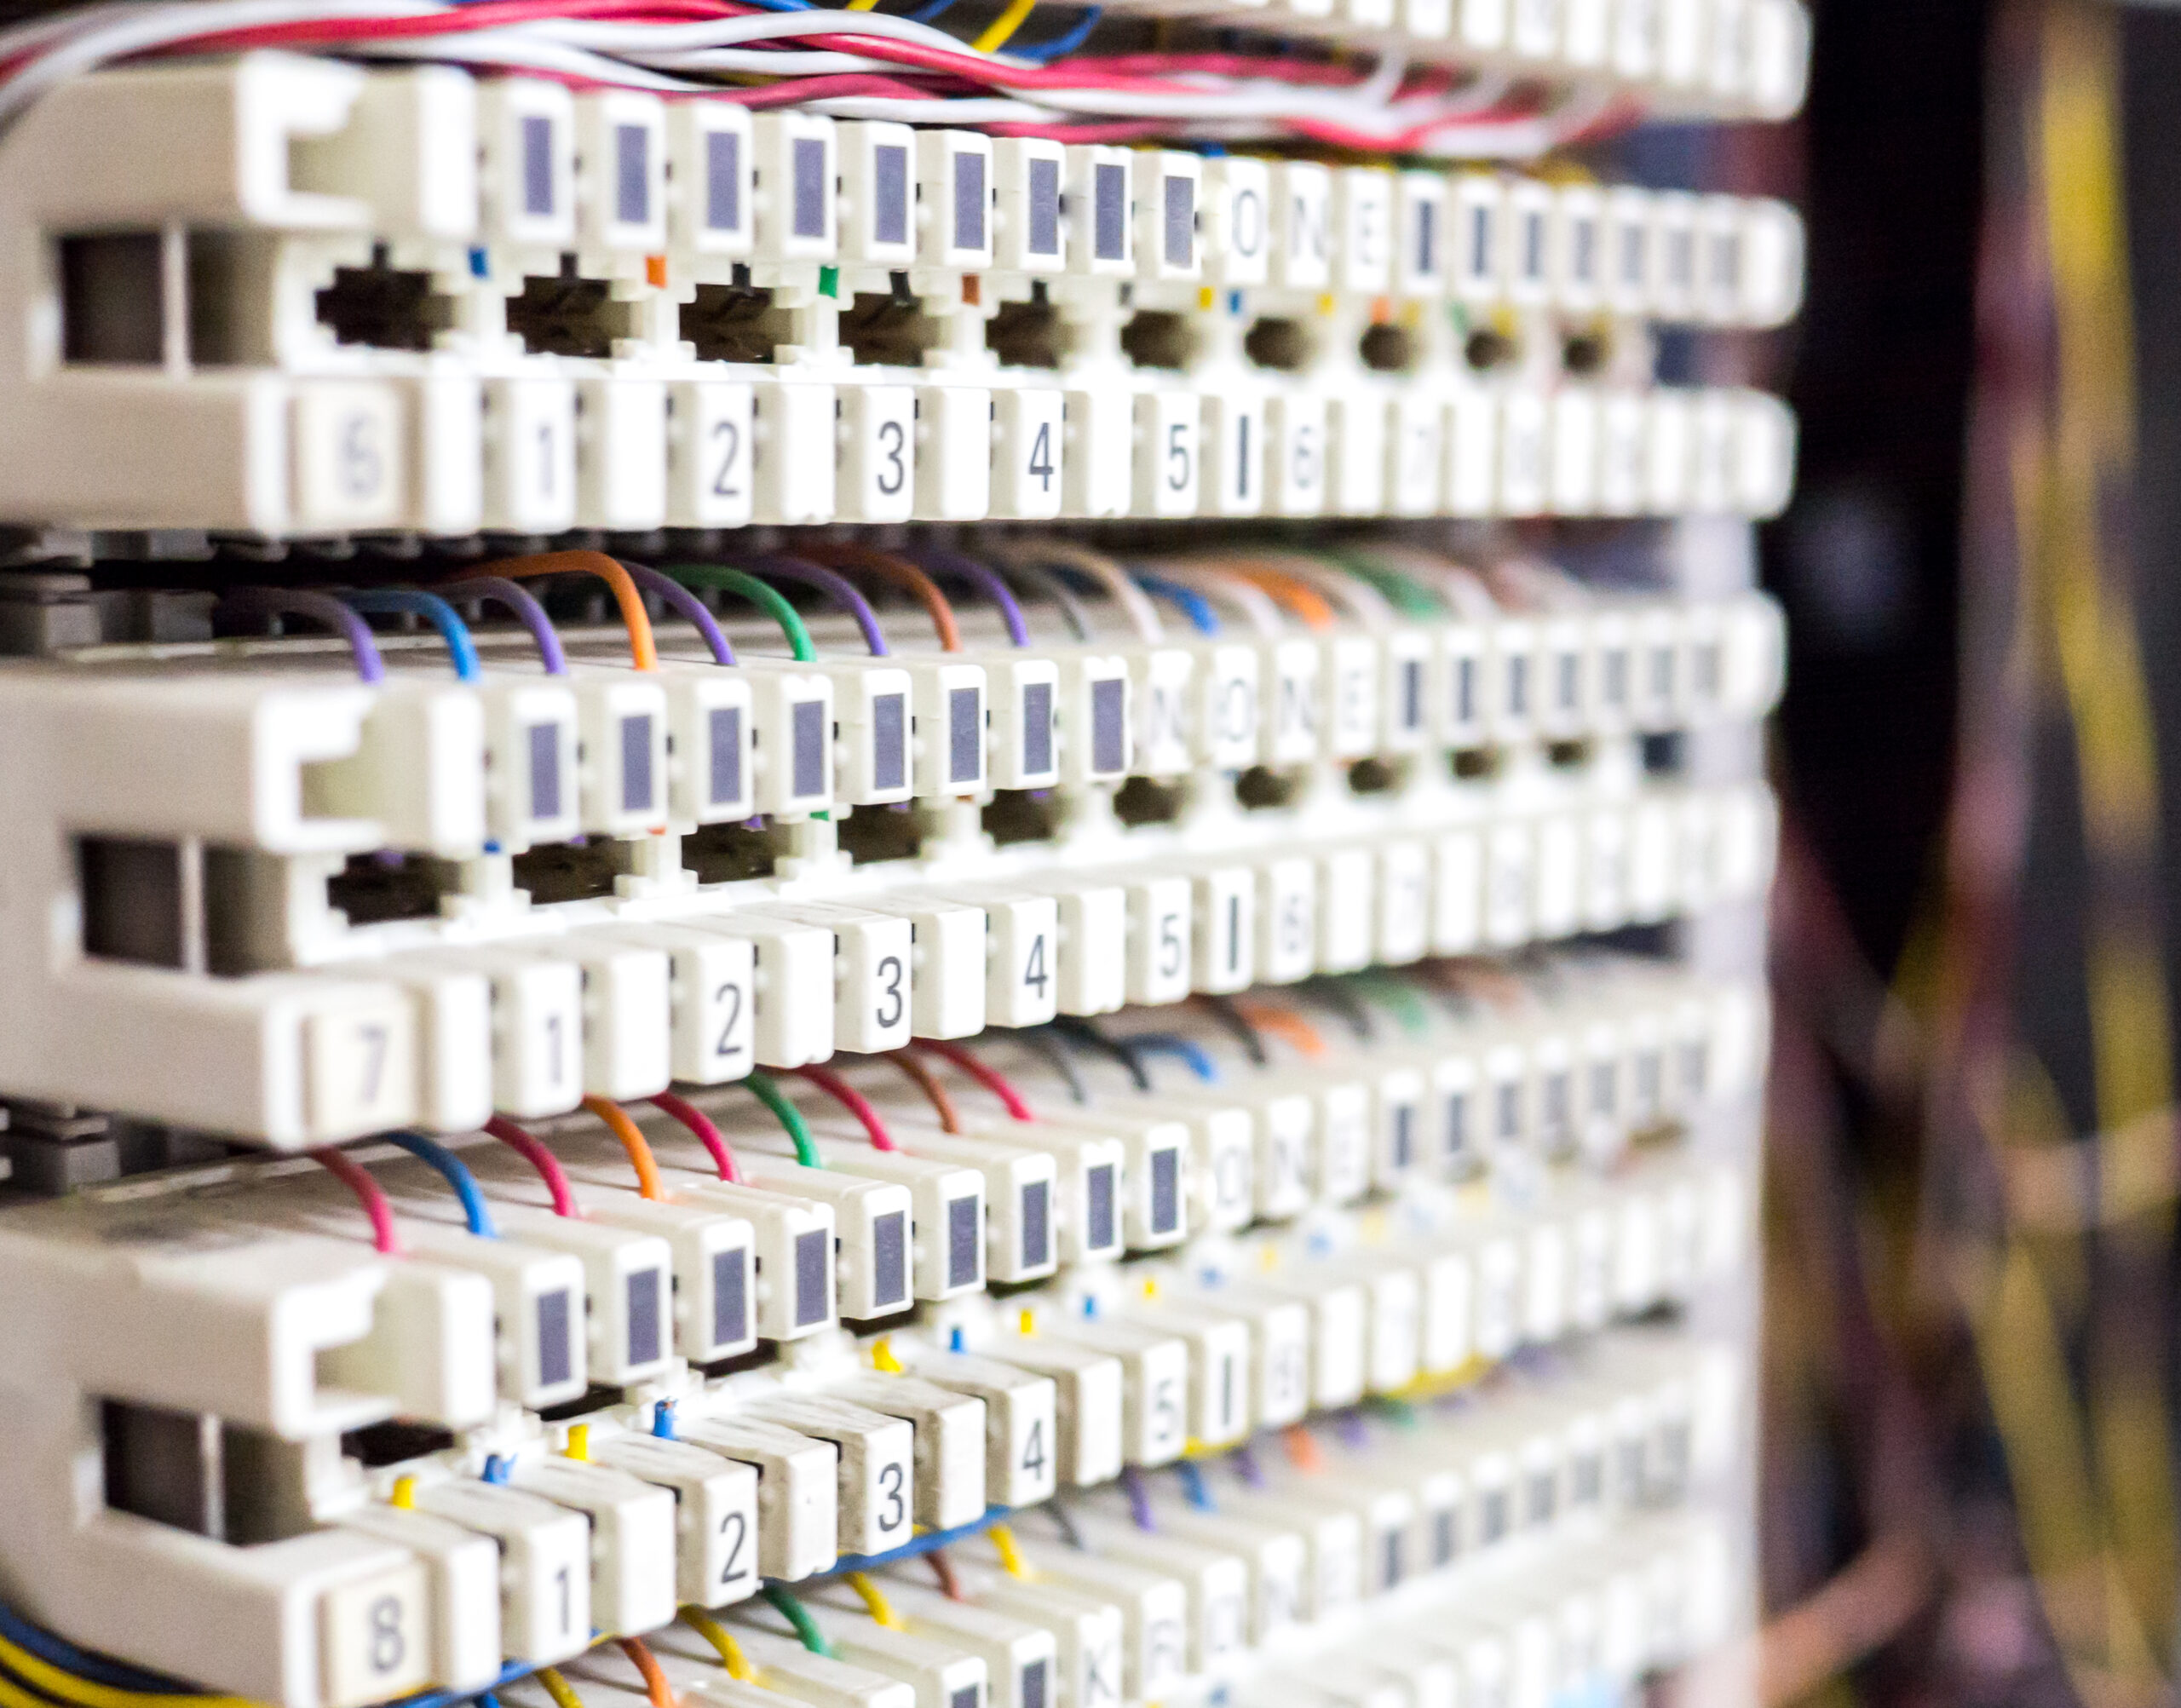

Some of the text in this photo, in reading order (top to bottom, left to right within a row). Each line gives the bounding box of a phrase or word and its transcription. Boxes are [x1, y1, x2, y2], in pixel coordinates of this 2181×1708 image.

[536, 421, 555, 500] 1
[711, 418, 740, 499] 2
[878, 420, 905, 497] 3
[1027, 422, 1055, 493] 4
[1168, 423, 1191, 492] 5
[1291, 424, 1321, 491] 6
[357, 1023, 392, 1106] 7
[545, 1013, 564, 1087] 1
[714, 981, 743, 1058] 2
[876, 955, 903, 1029] 3
[1023, 934, 1049, 1000] 4
[1160, 912, 1183, 980] 5
[366, 1593, 407, 1675] 8
[554, 1564, 571, 1636] 1
[719, 1510, 748, 1585] 2
[878, 1462, 905, 1533] 3
[1021, 1418, 1046, 1481] 4
[1153, 1374, 1181, 1444] 5
